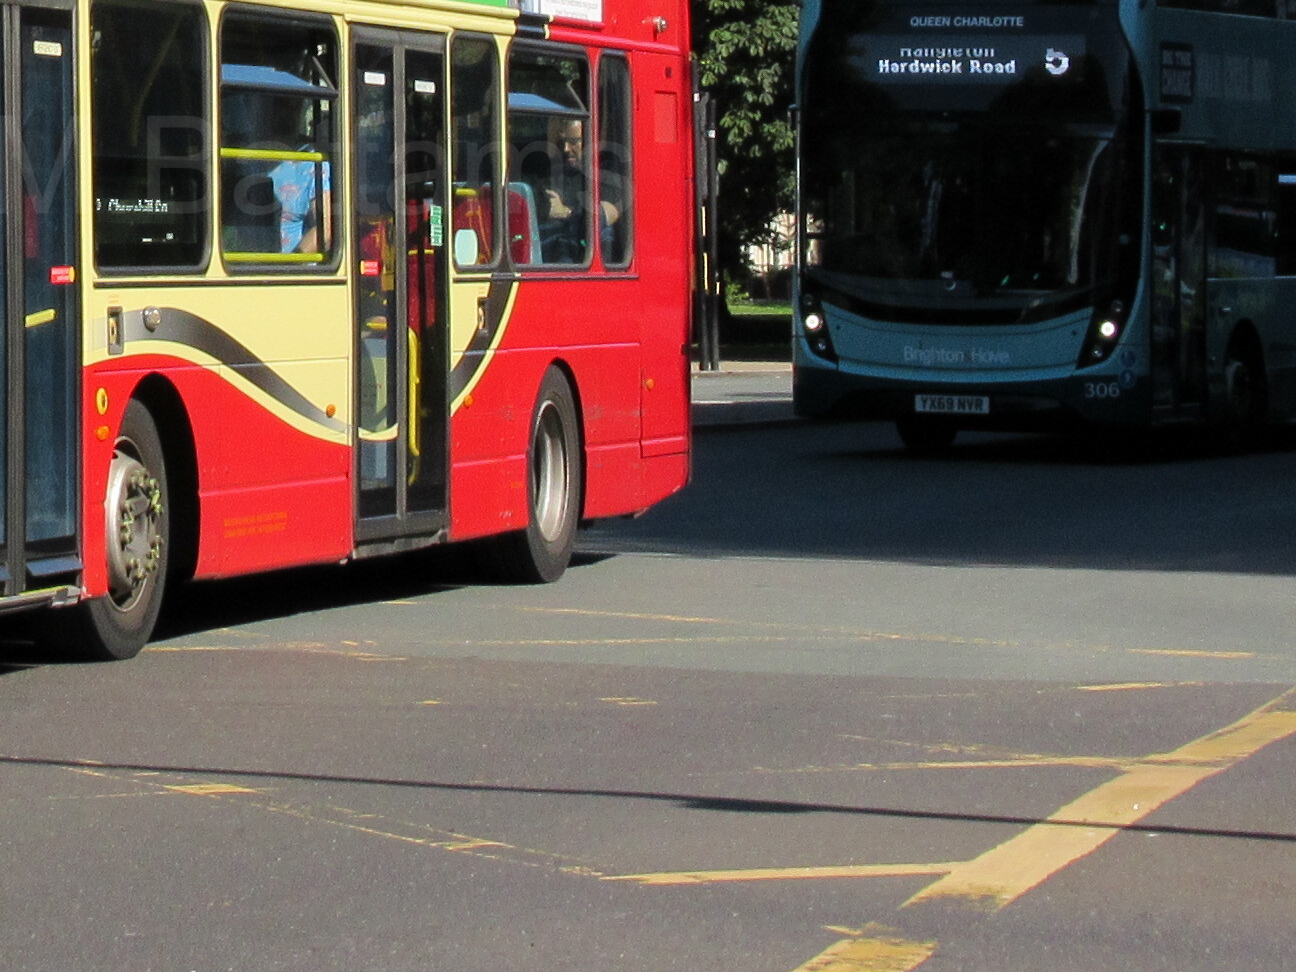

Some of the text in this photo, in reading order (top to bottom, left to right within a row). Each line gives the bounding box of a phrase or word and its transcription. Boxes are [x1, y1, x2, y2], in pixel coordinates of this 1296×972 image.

[910, 15, 1024, 27] QUEEN CHARLOTTE
[878, 59, 1016, 74] Hardwick Road
[1085, 383, 1120, 397] 306
